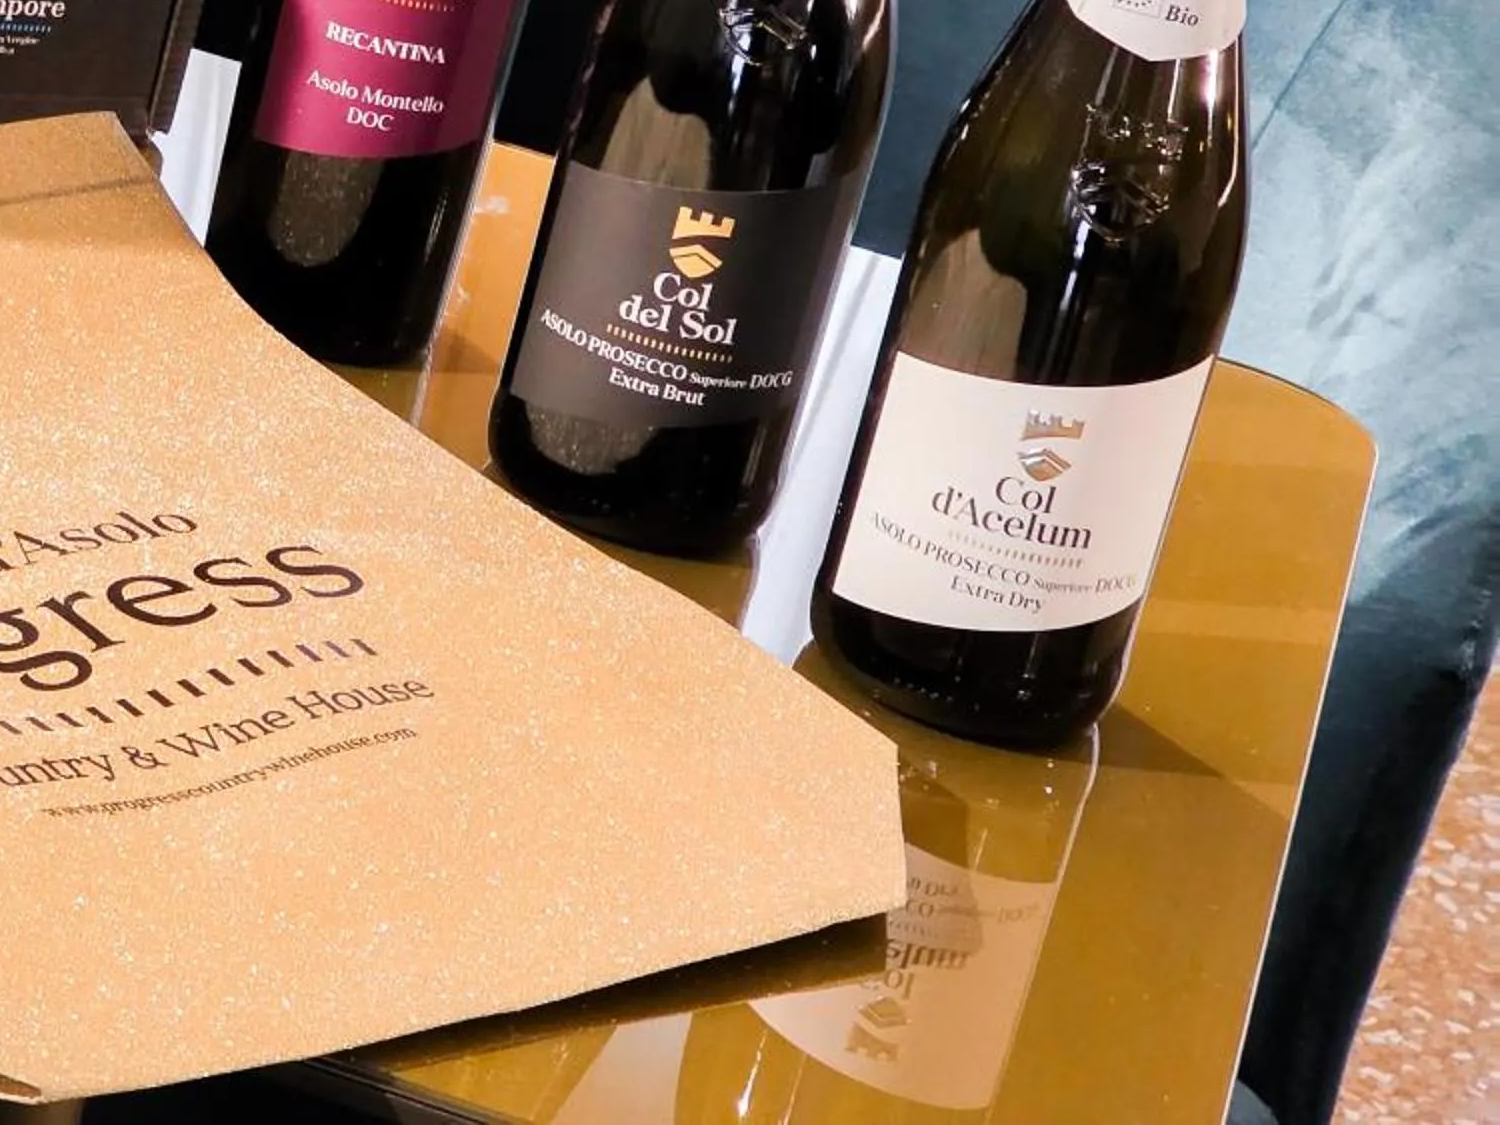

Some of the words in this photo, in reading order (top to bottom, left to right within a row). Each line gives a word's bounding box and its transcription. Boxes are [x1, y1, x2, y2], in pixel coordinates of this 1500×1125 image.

[1165, 4, 1200, 27] Bio
[325, 21, 446, 65] RECANTINA
[306, 69, 358, 100] Asolo
[361, 86, 444, 114] Montello
[346, 106, 394, 132] DOC
[653, 272, 713, 312] Col
[619, 295, 671, 333] del
[679, 310, 738, 346] Sol
[540, 308, 588, 347] ASOLO
[587, 337, 688, 381] PROSECCO
[609, 367, 660, 399] Extra
[663, 383, 706, 407] Brut
[995, 475, 1057, 515] Col
[932, 485, 1092, 550] d'Acelum
[871, 512, 922, 552] ASOLO
[924, 541, 1030, 587] PROSECCO
[950, 574, 1004, 604] Extra
[1008, 590, 1047, 615] Dry
[120, 744, 170, 770] &
[155, 709, 294, 759] Wine
[286, 673, 436, 721] House
